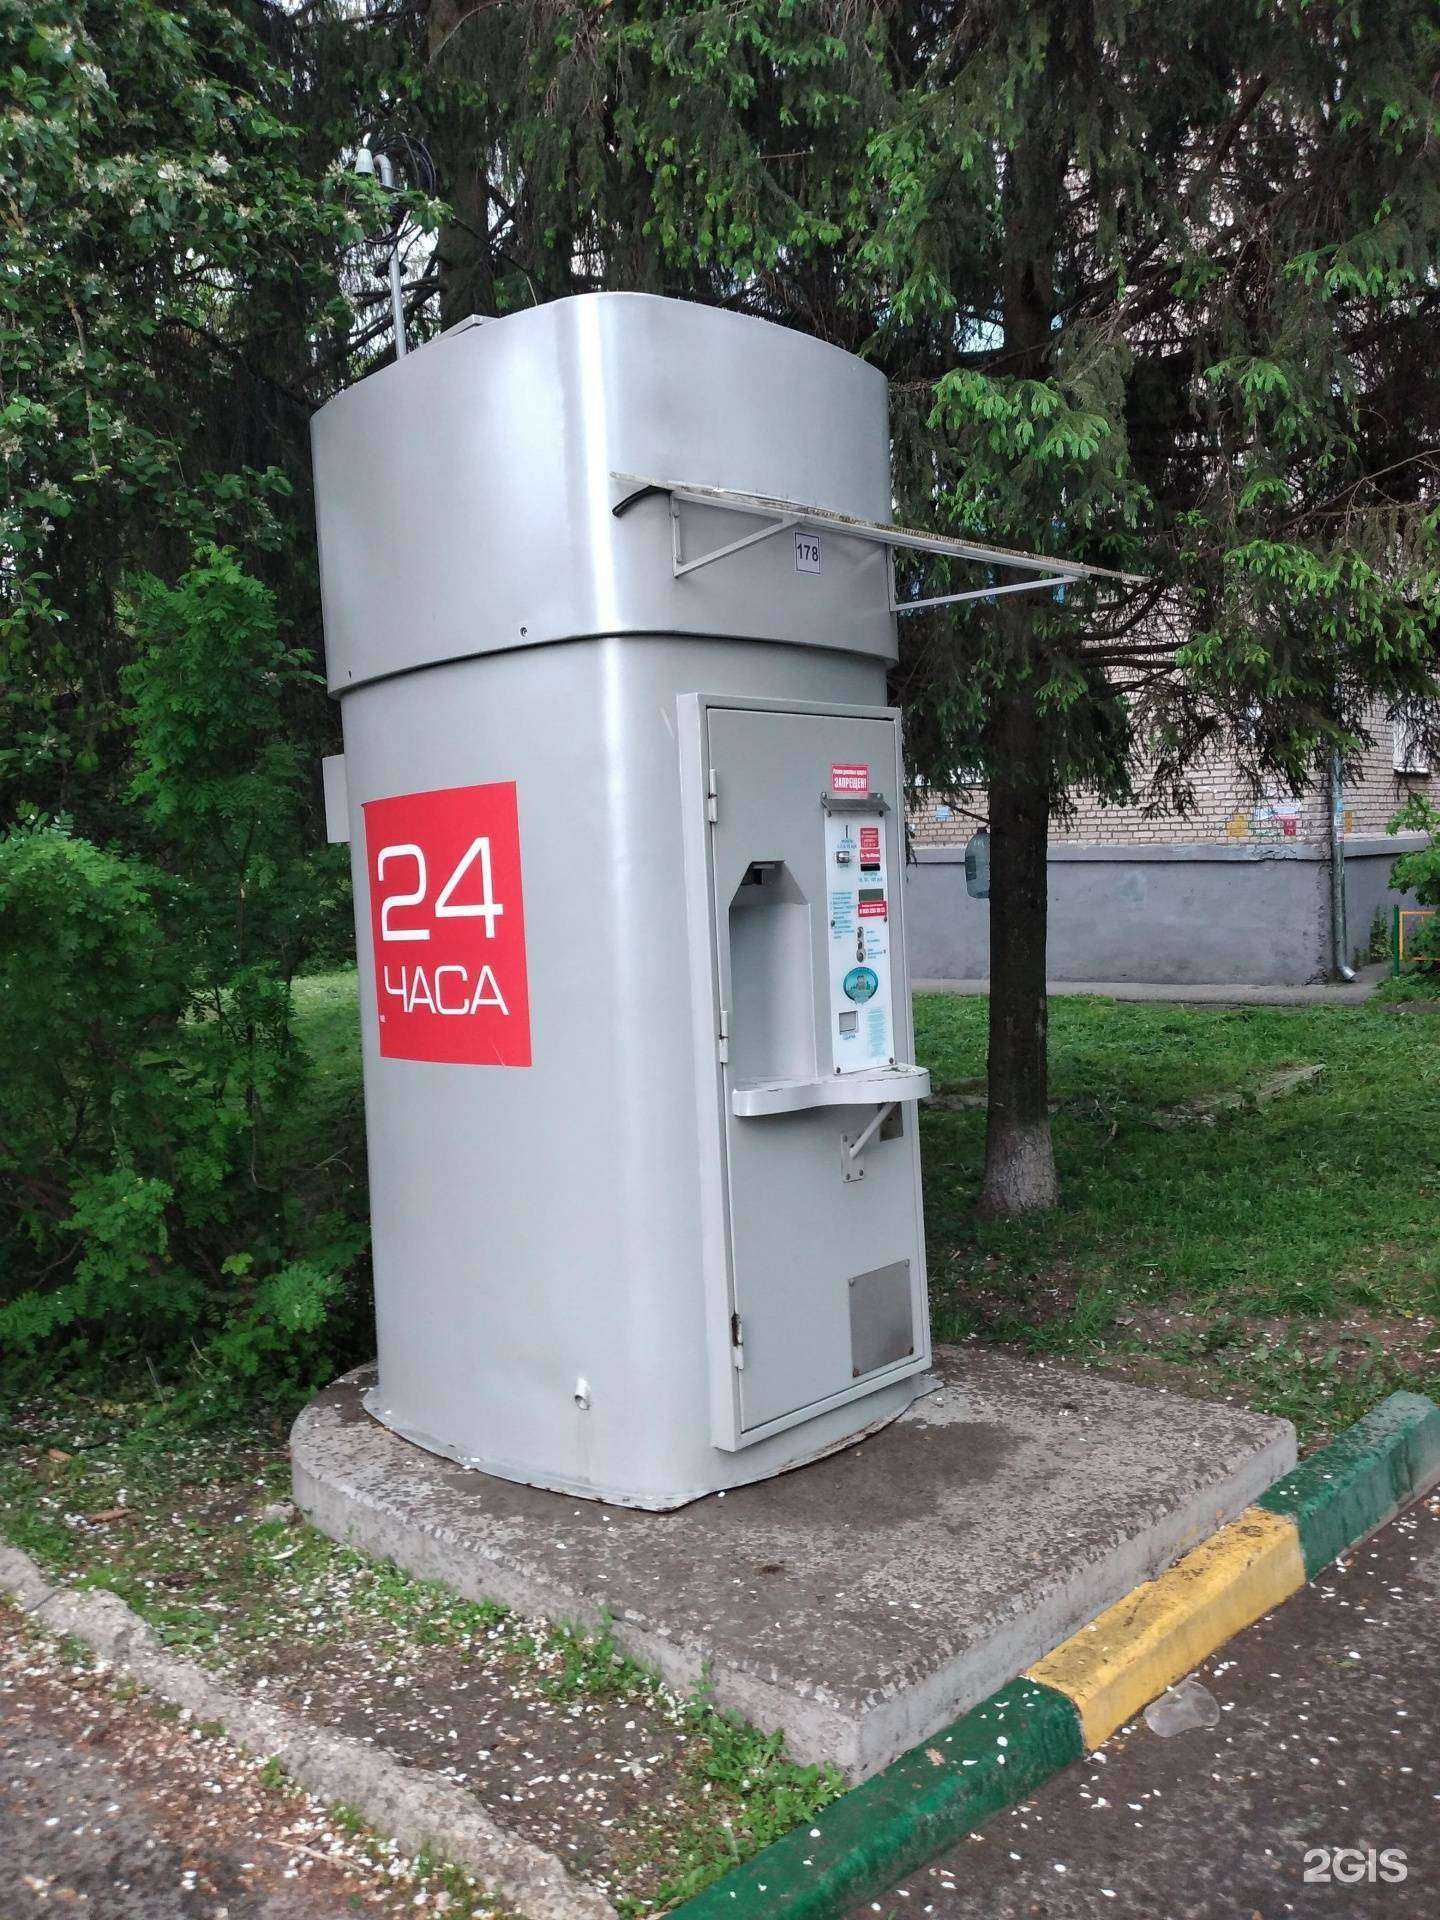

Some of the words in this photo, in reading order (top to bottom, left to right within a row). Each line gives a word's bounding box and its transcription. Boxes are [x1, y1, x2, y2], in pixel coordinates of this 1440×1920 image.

[797, 543, 819, 562] 178
[377, 836, 504, 941] 24
[384, 965, 510, 1016] ЧАСА
